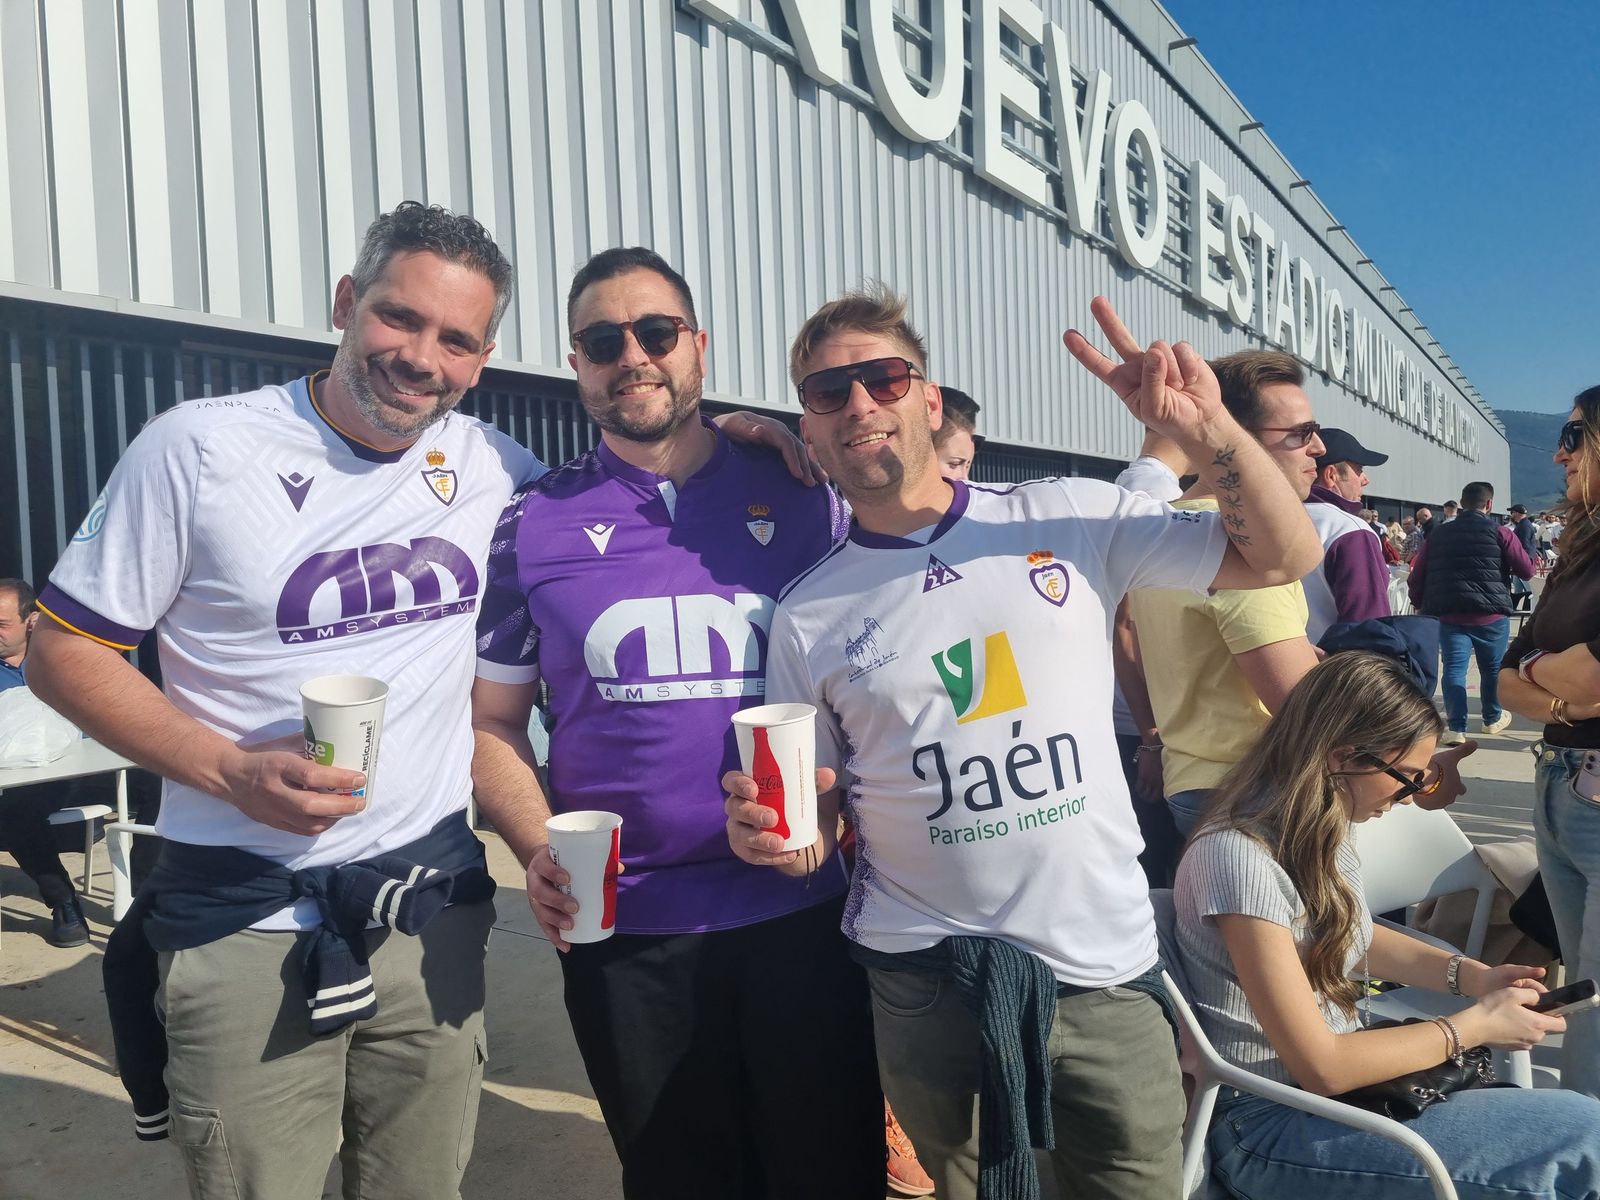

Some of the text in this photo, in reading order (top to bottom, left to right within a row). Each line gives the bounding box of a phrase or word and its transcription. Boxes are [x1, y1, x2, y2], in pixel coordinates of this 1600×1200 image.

[689, 0, 1168, 269] UEVO
[1190, 159, 1348, 380] ESTADIO
[1350, 306, 1429, 433] MUNICIPAL
[605, 681, 766, 700] AMSYSTE
[912, 719, 1083, 822] Jaén
[929, 795, 1087, 845] Paraíso interior
